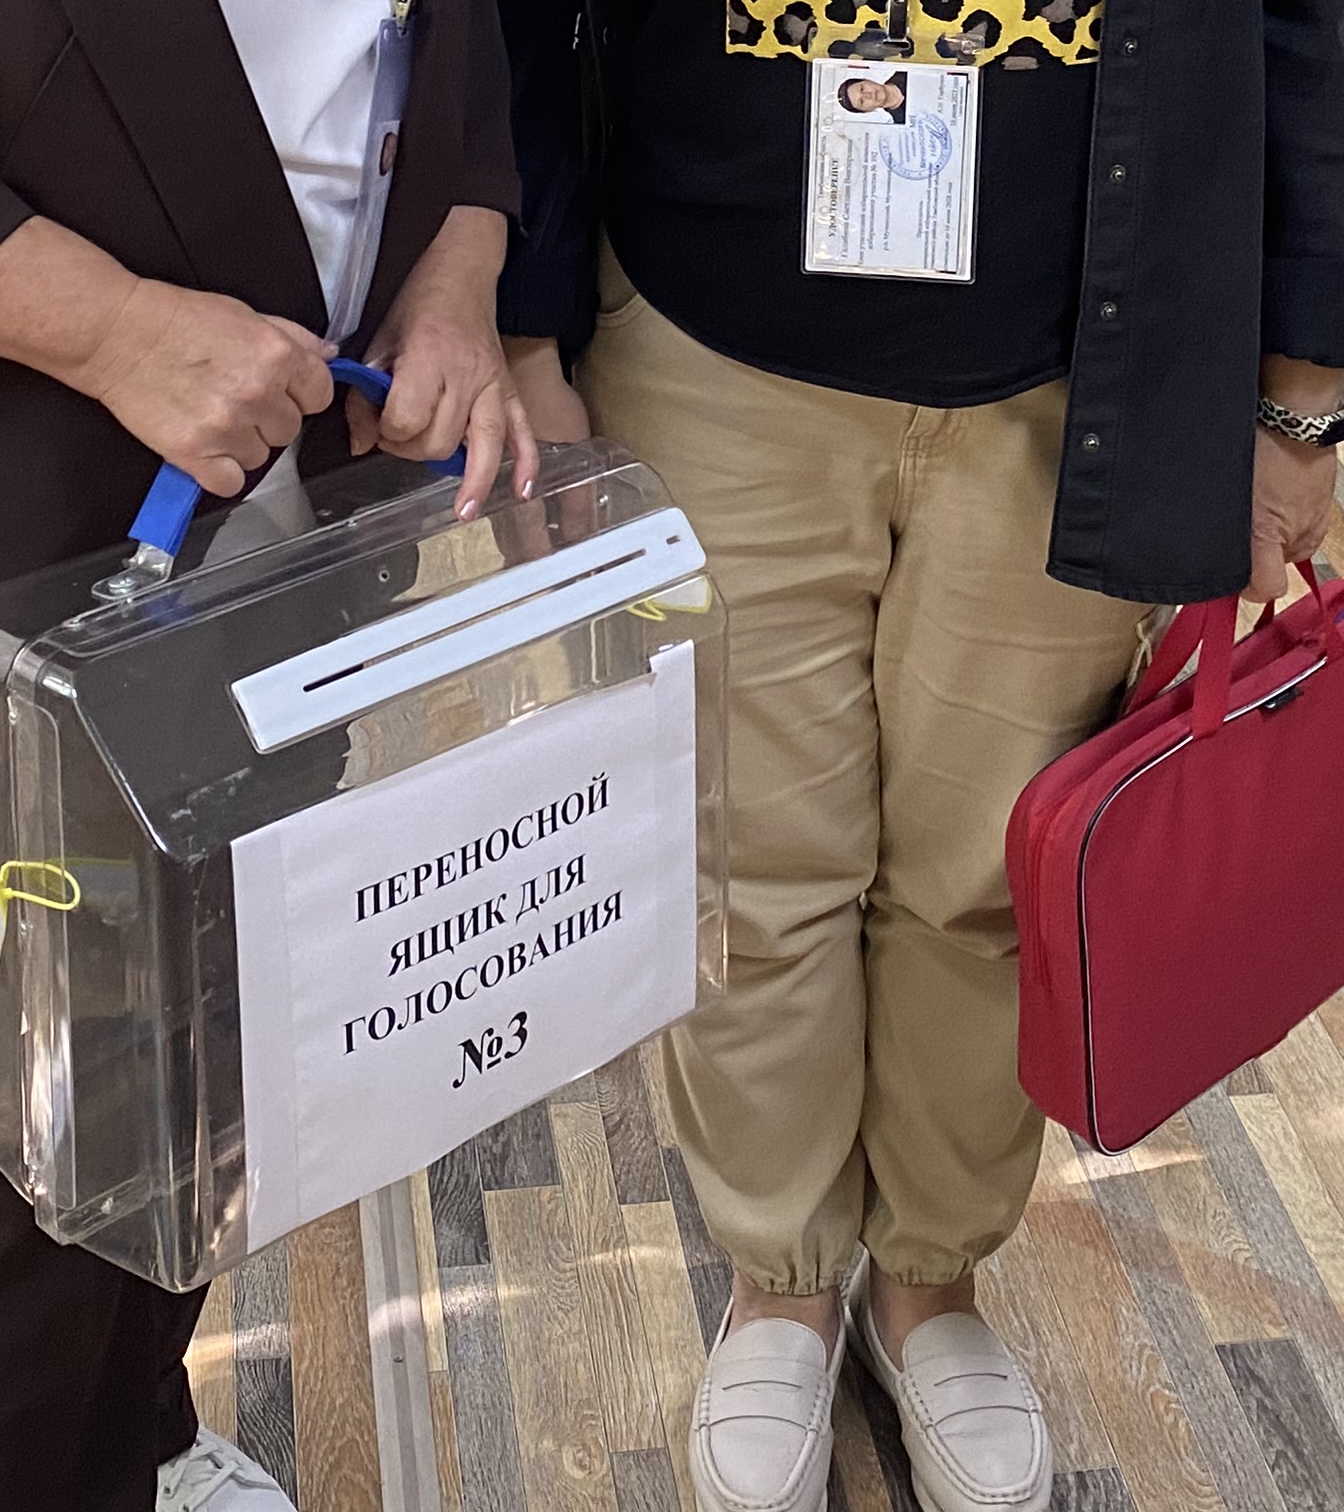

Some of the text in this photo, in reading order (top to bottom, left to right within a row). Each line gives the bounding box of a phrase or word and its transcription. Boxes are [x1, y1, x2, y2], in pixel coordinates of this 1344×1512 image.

[354, 771, 612, 924] ПЕРЕНОСНОЙ
[386, 853, 588, 977] ЯЩИК ДЛЯ
[342, 890, 624, 1056] ГОЛОСОВАНИЯ
[451, 1011, 530, 1089] №3
